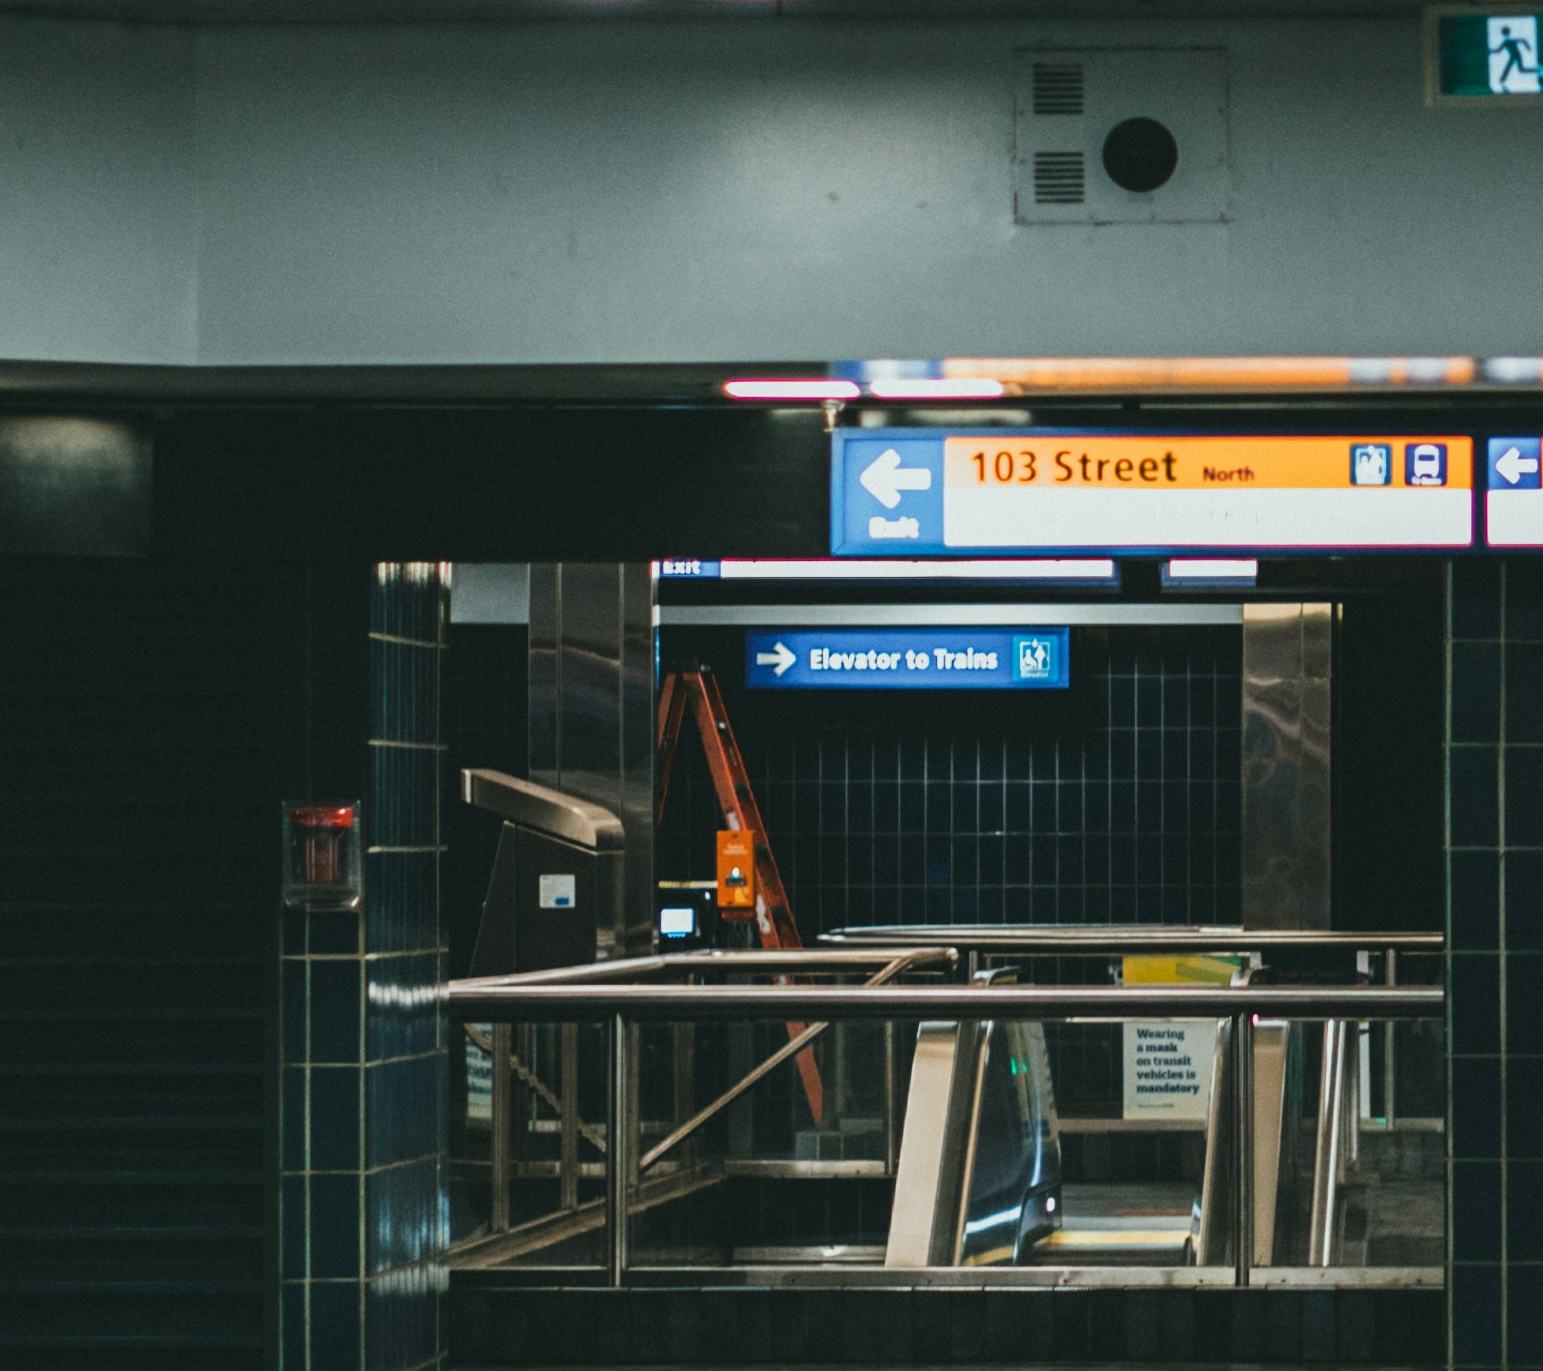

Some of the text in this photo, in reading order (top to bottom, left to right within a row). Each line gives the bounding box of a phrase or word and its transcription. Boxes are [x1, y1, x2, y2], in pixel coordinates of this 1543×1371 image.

[972, 451, 1255, 483] 103 Street North
[810, 647, 998, 670] Elevator to Trains
[1136, 1029, 1185, 1040] Wearing
[1136, 1042, 1178, 1052] a mask
[1136, 1055, 1191, 1066] on transit
[1136, 1069, 1196, 1079] vehicles is
[1136, 1082, 1200, 1095] mandatory
